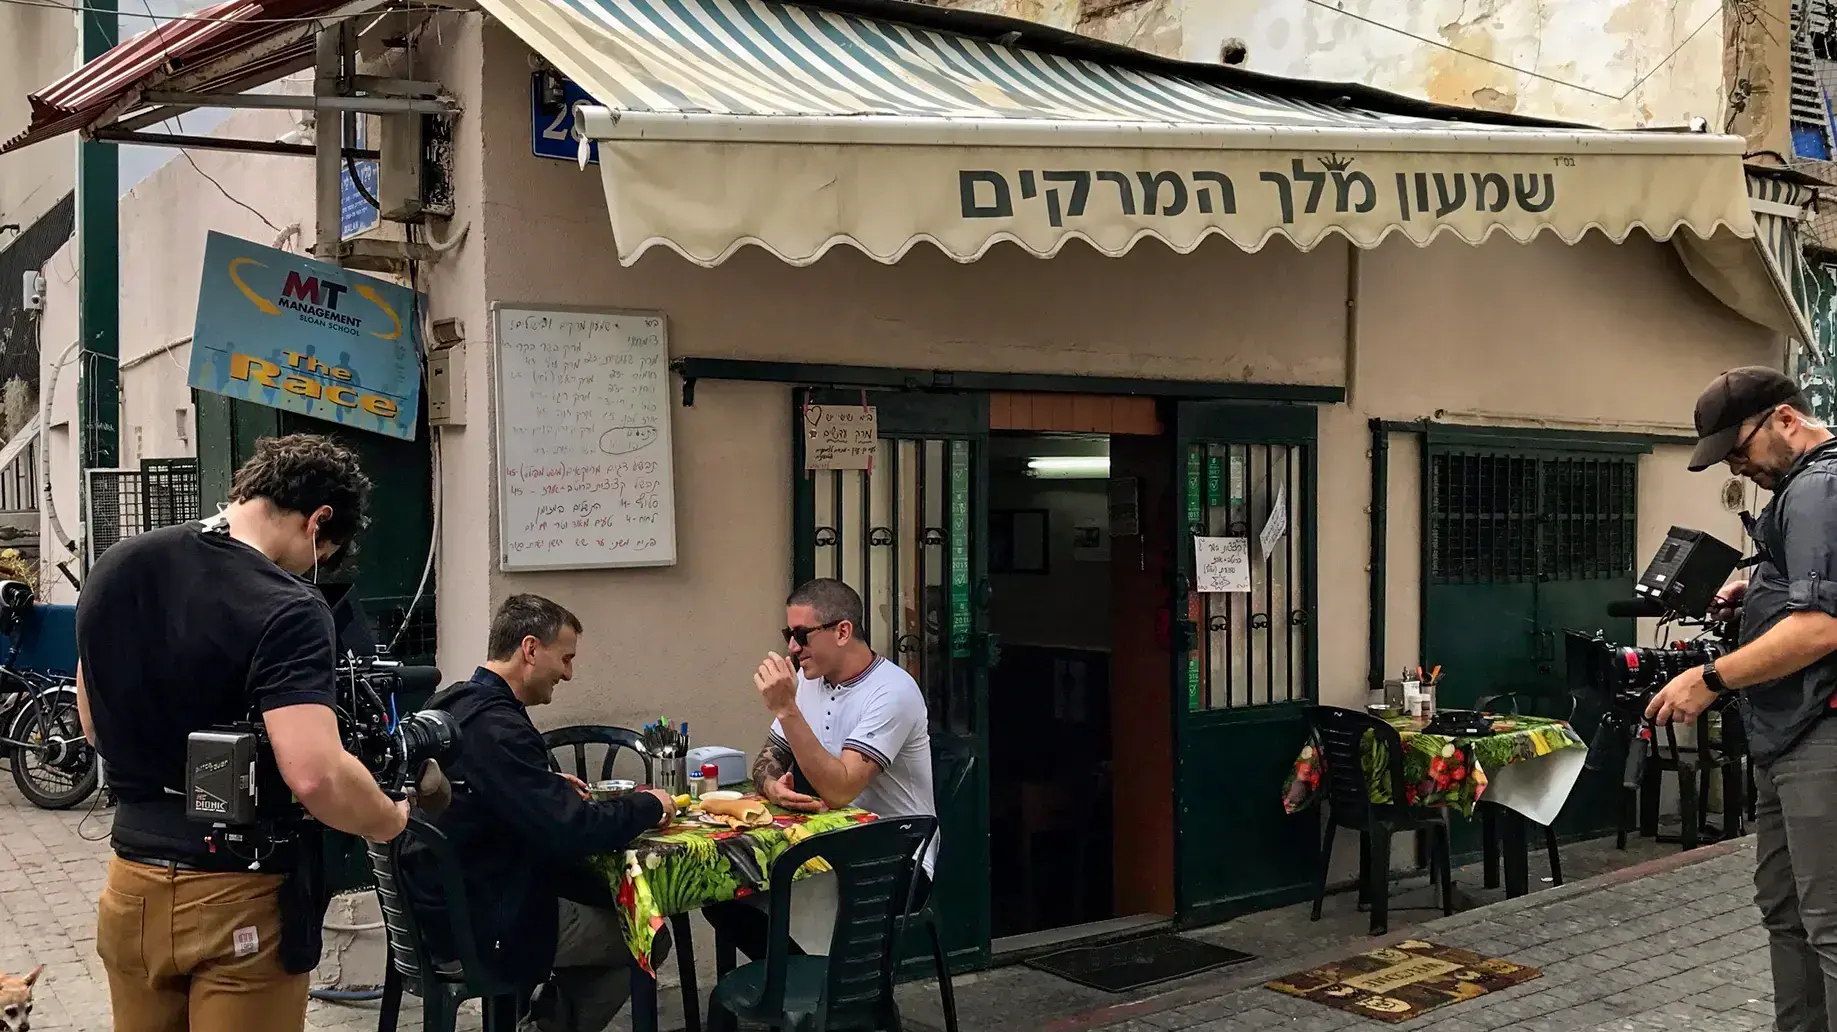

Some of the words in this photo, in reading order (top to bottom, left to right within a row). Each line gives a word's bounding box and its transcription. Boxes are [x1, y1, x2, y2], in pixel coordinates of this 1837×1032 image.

[958, 169, 1236, 228] המרקים
[1260, 158, 1377, 224] מלך
[1397, 172, 1556, 221] שמעון
[278, 298, 363, 328] MANAGEMENT
[299, 314, 326, 327] SLOAN
[328, 322, 361, 337] SCHOOL
[282, 350, 353, 381] The
[230, 352, 398, 419] Race
[854, 428, 873, 444] מרק
[195, 800, 226, 811] DIONIC
